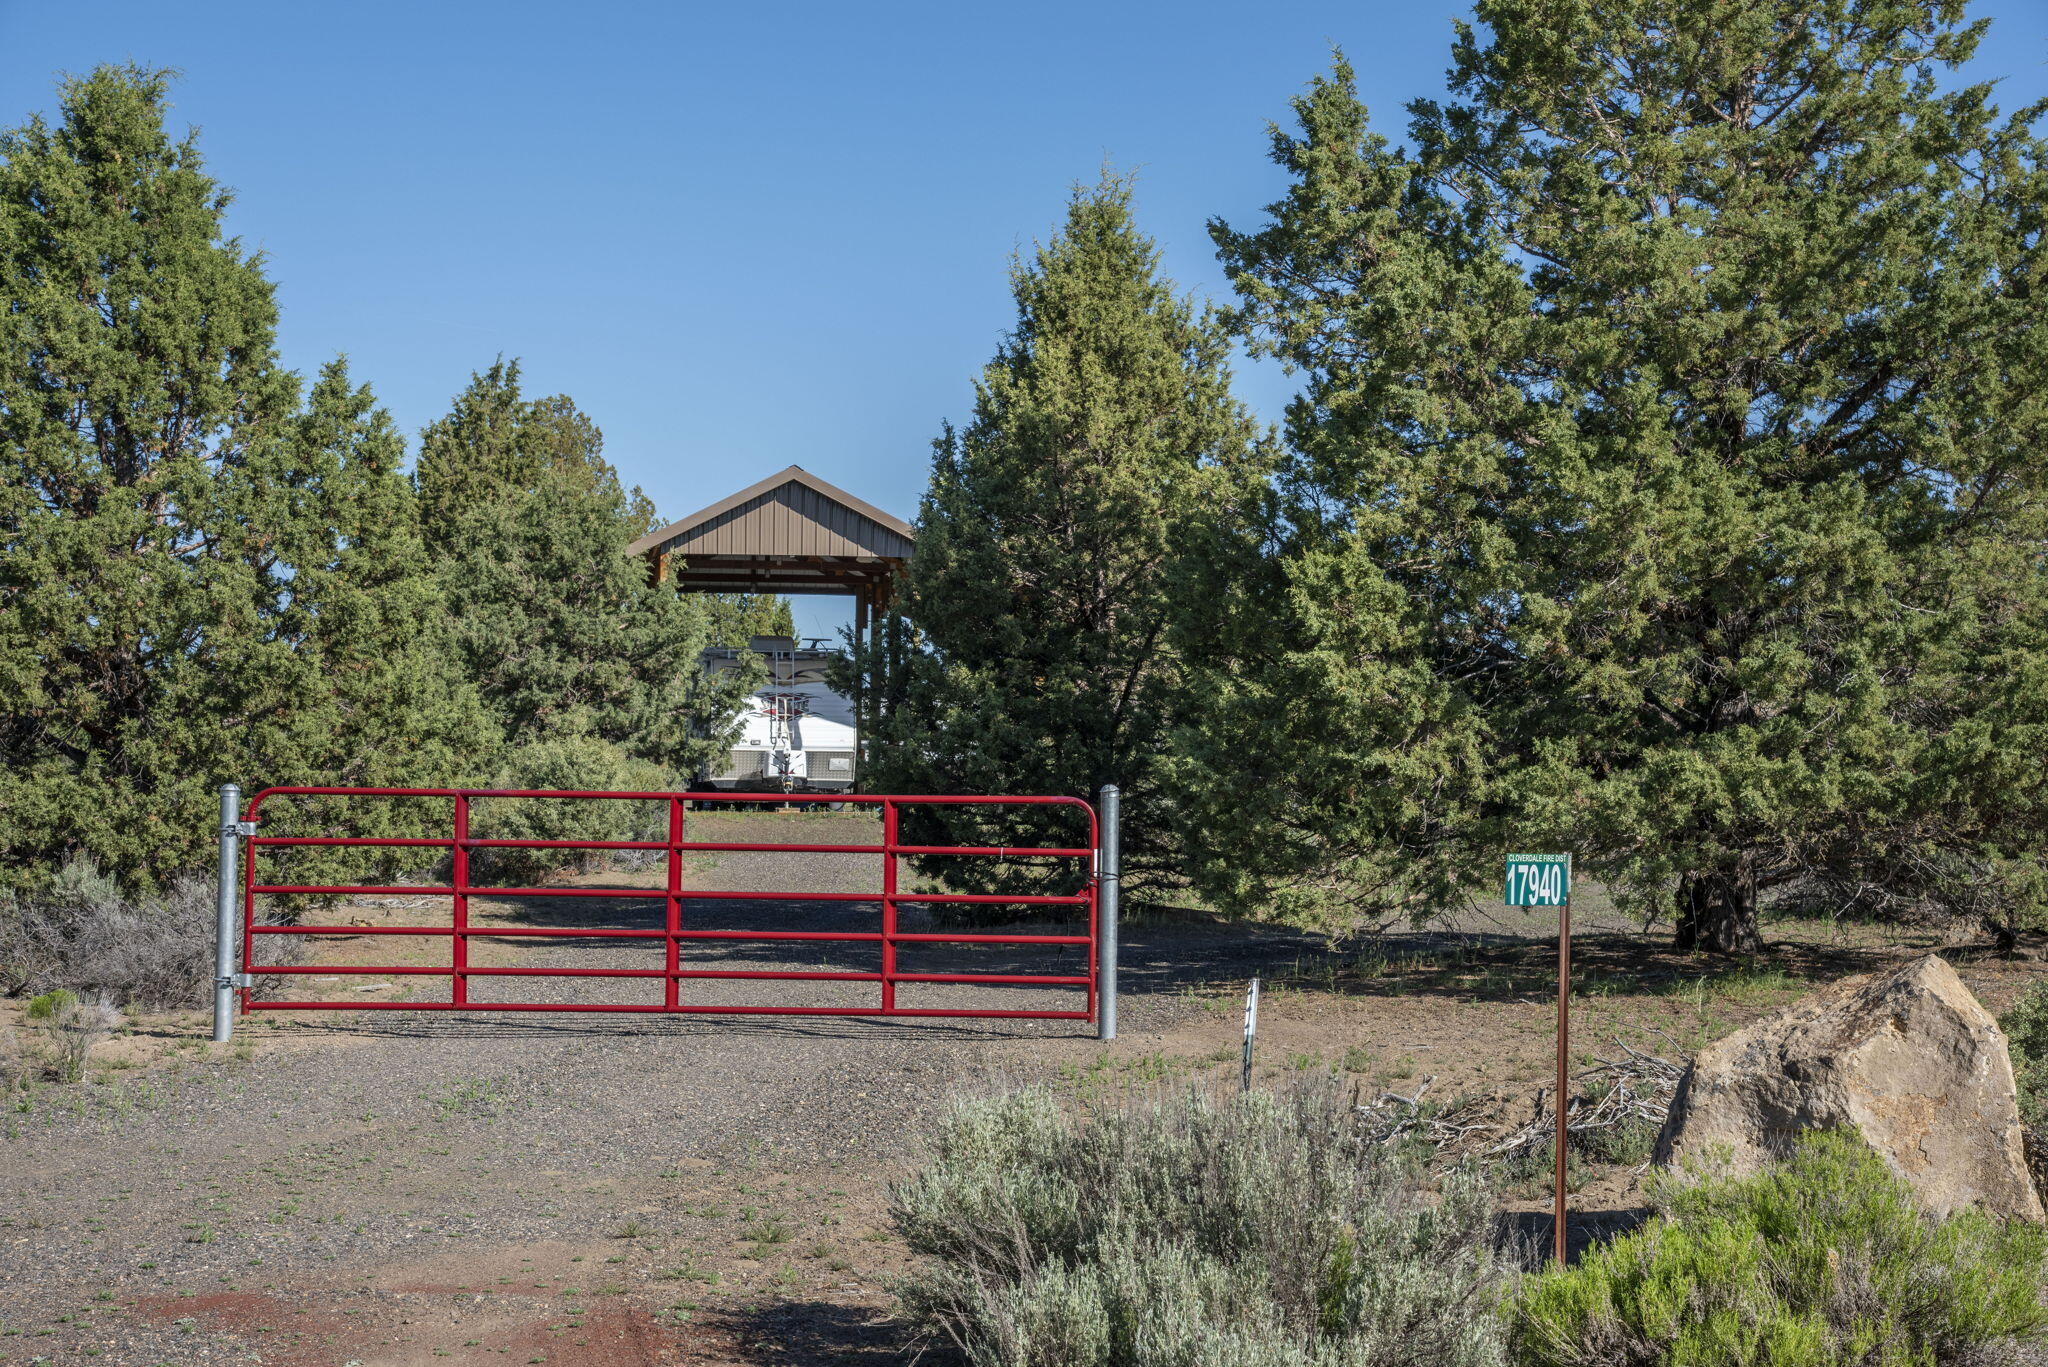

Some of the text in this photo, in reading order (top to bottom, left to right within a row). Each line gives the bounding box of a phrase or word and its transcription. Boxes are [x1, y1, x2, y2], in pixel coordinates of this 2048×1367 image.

[1508, 854, 1566, 862] CLOVERDALE FIRE DIST
[1507, 864, 1561, 905] 17940
